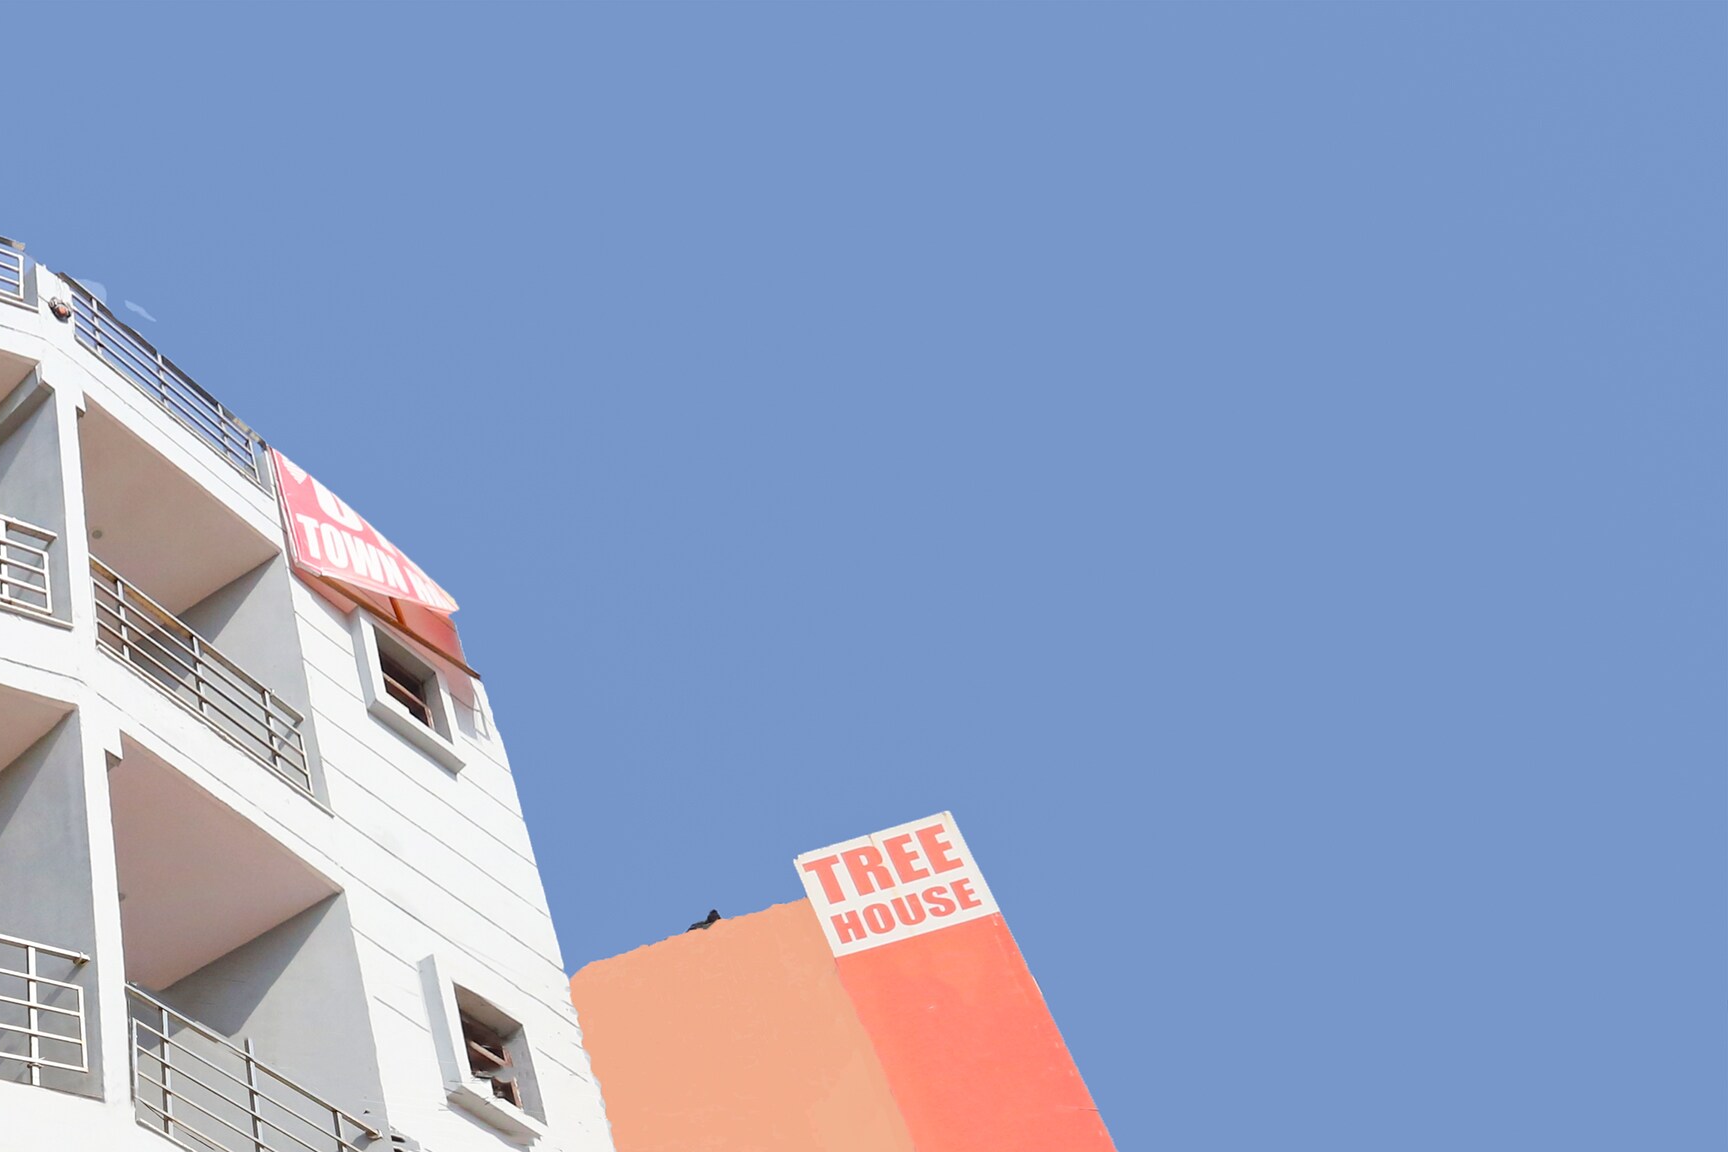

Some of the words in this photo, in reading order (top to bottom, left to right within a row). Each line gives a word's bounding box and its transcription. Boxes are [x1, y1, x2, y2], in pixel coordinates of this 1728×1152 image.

[295, 512, 411, 594] TOWN
[802, 823, 965, 905] TREE
[830, 877, 983, 945] HOUSE
